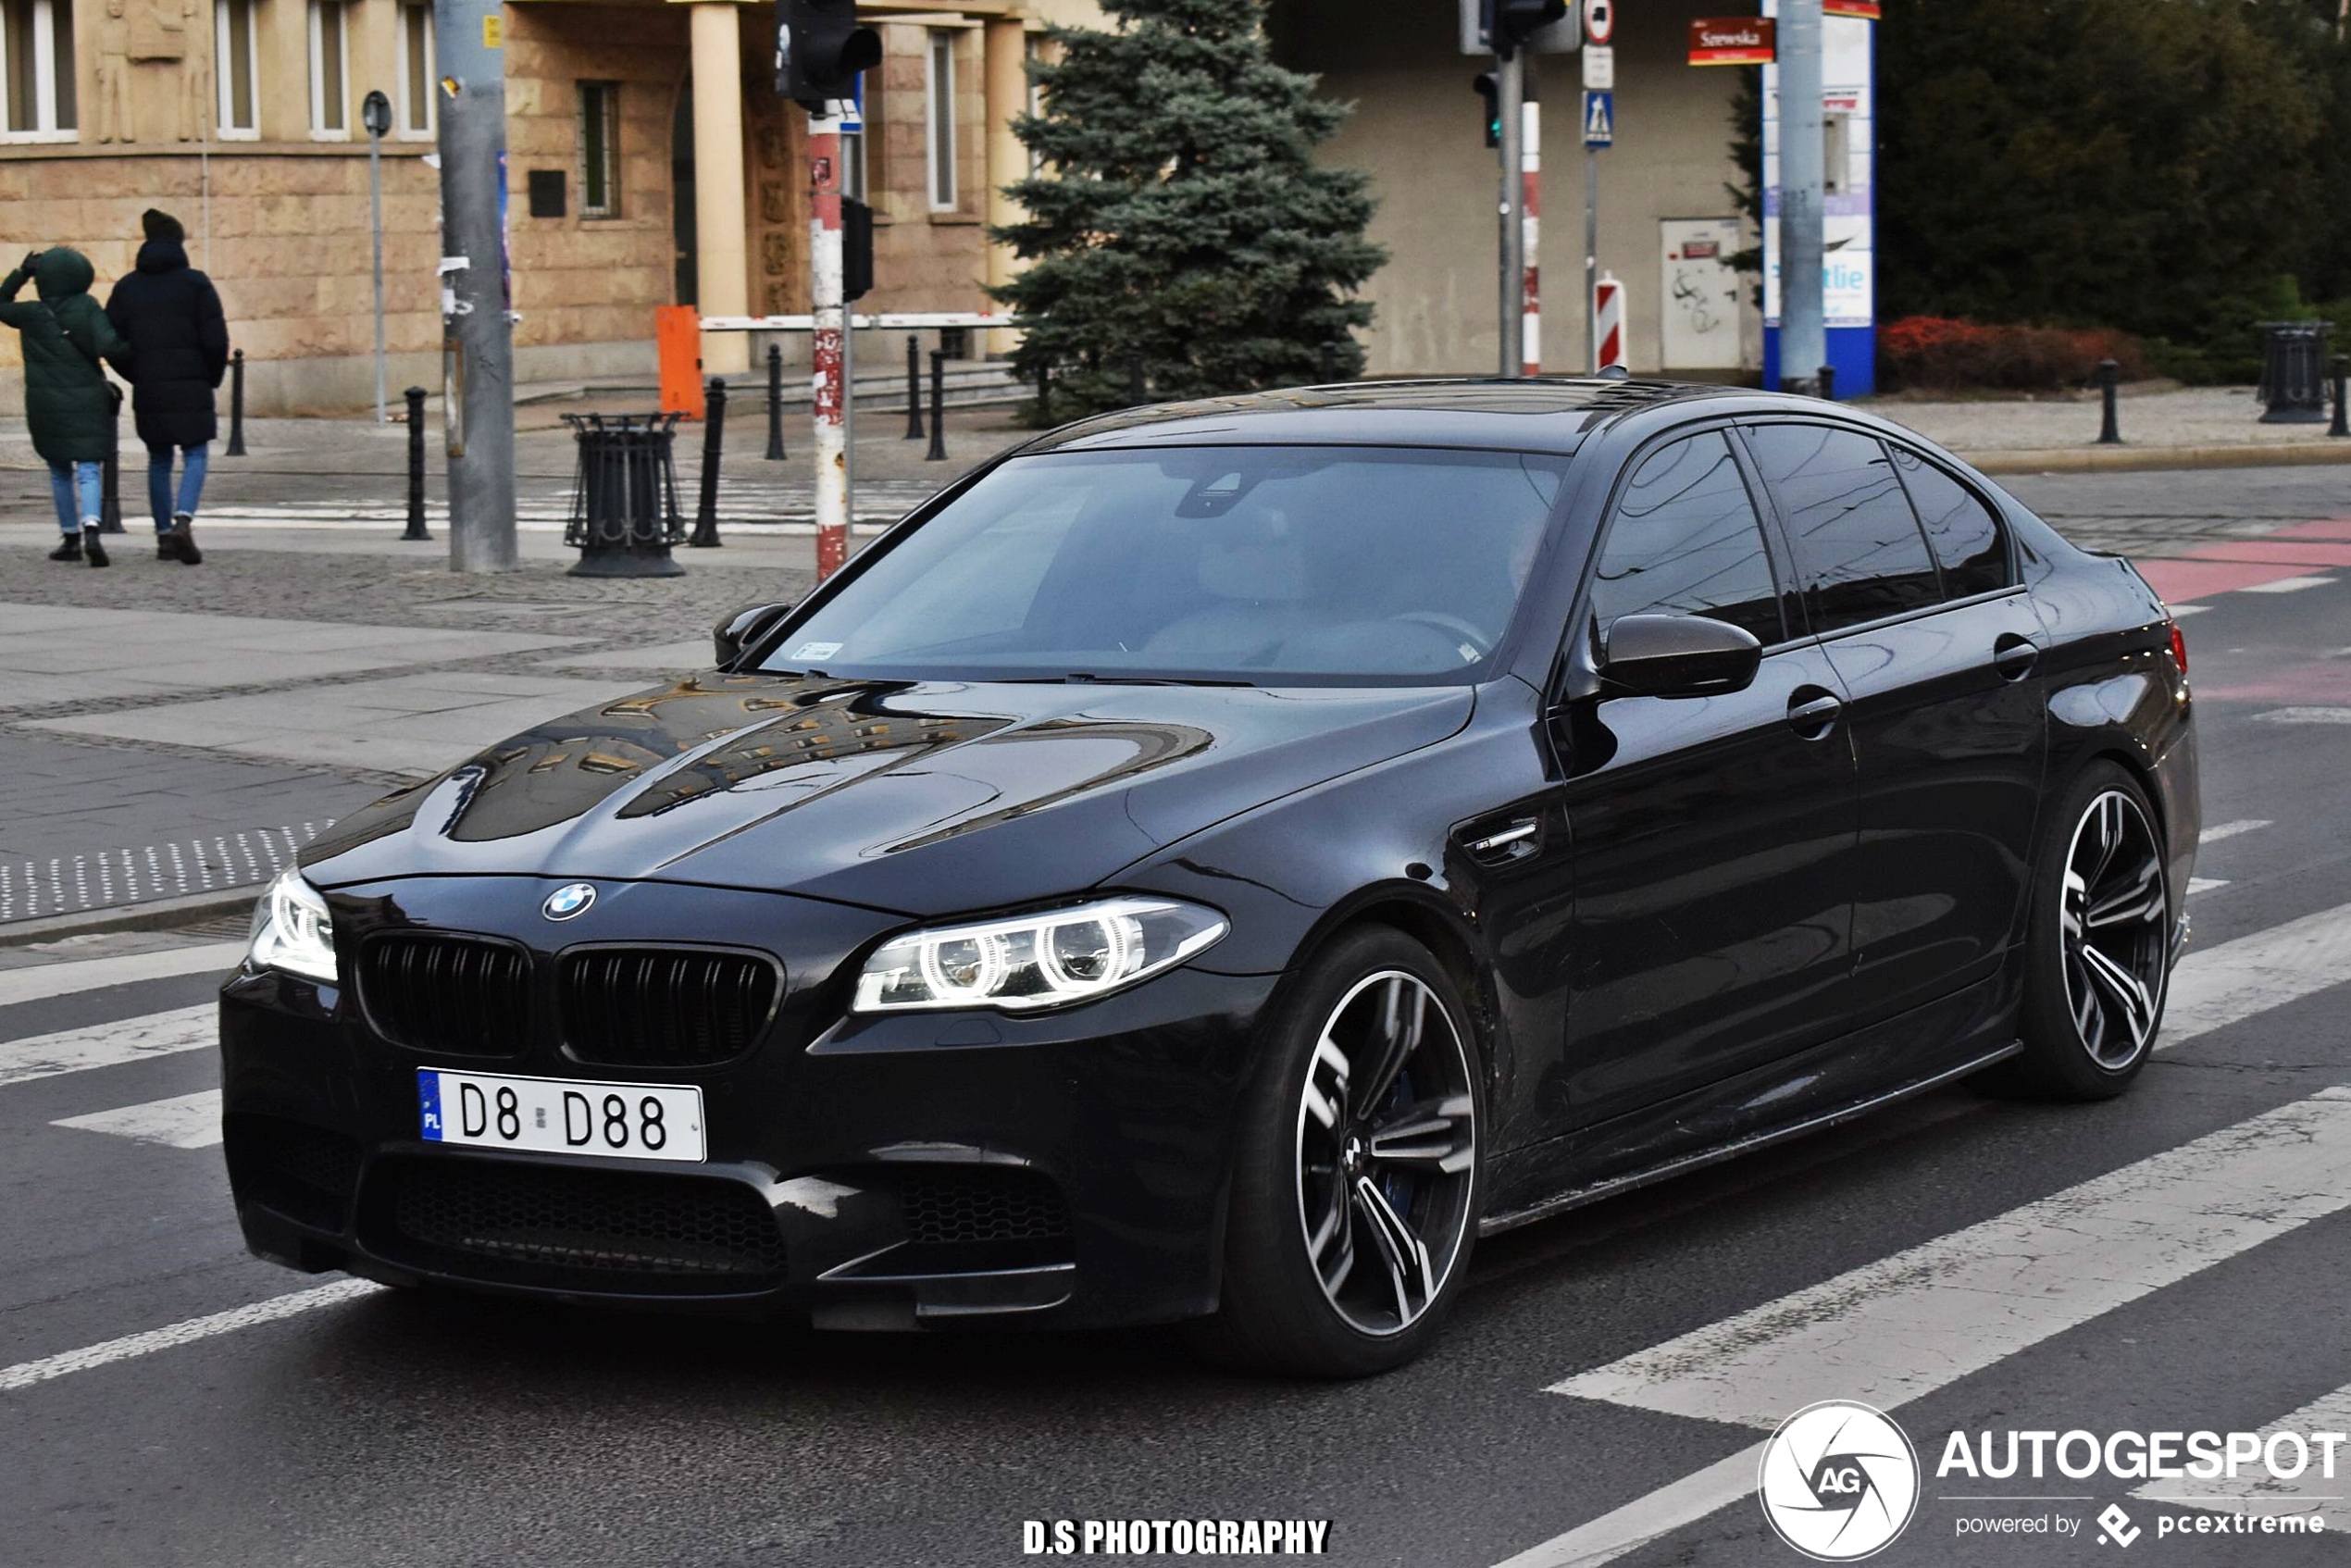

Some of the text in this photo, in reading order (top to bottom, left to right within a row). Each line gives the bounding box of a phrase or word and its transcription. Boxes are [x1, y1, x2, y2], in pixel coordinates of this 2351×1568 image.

[1699, 30, 1760, 47] Szewska
[424, 1113, 442, 1129] PL
[460, 1082, 666, 1151] D8 D88
